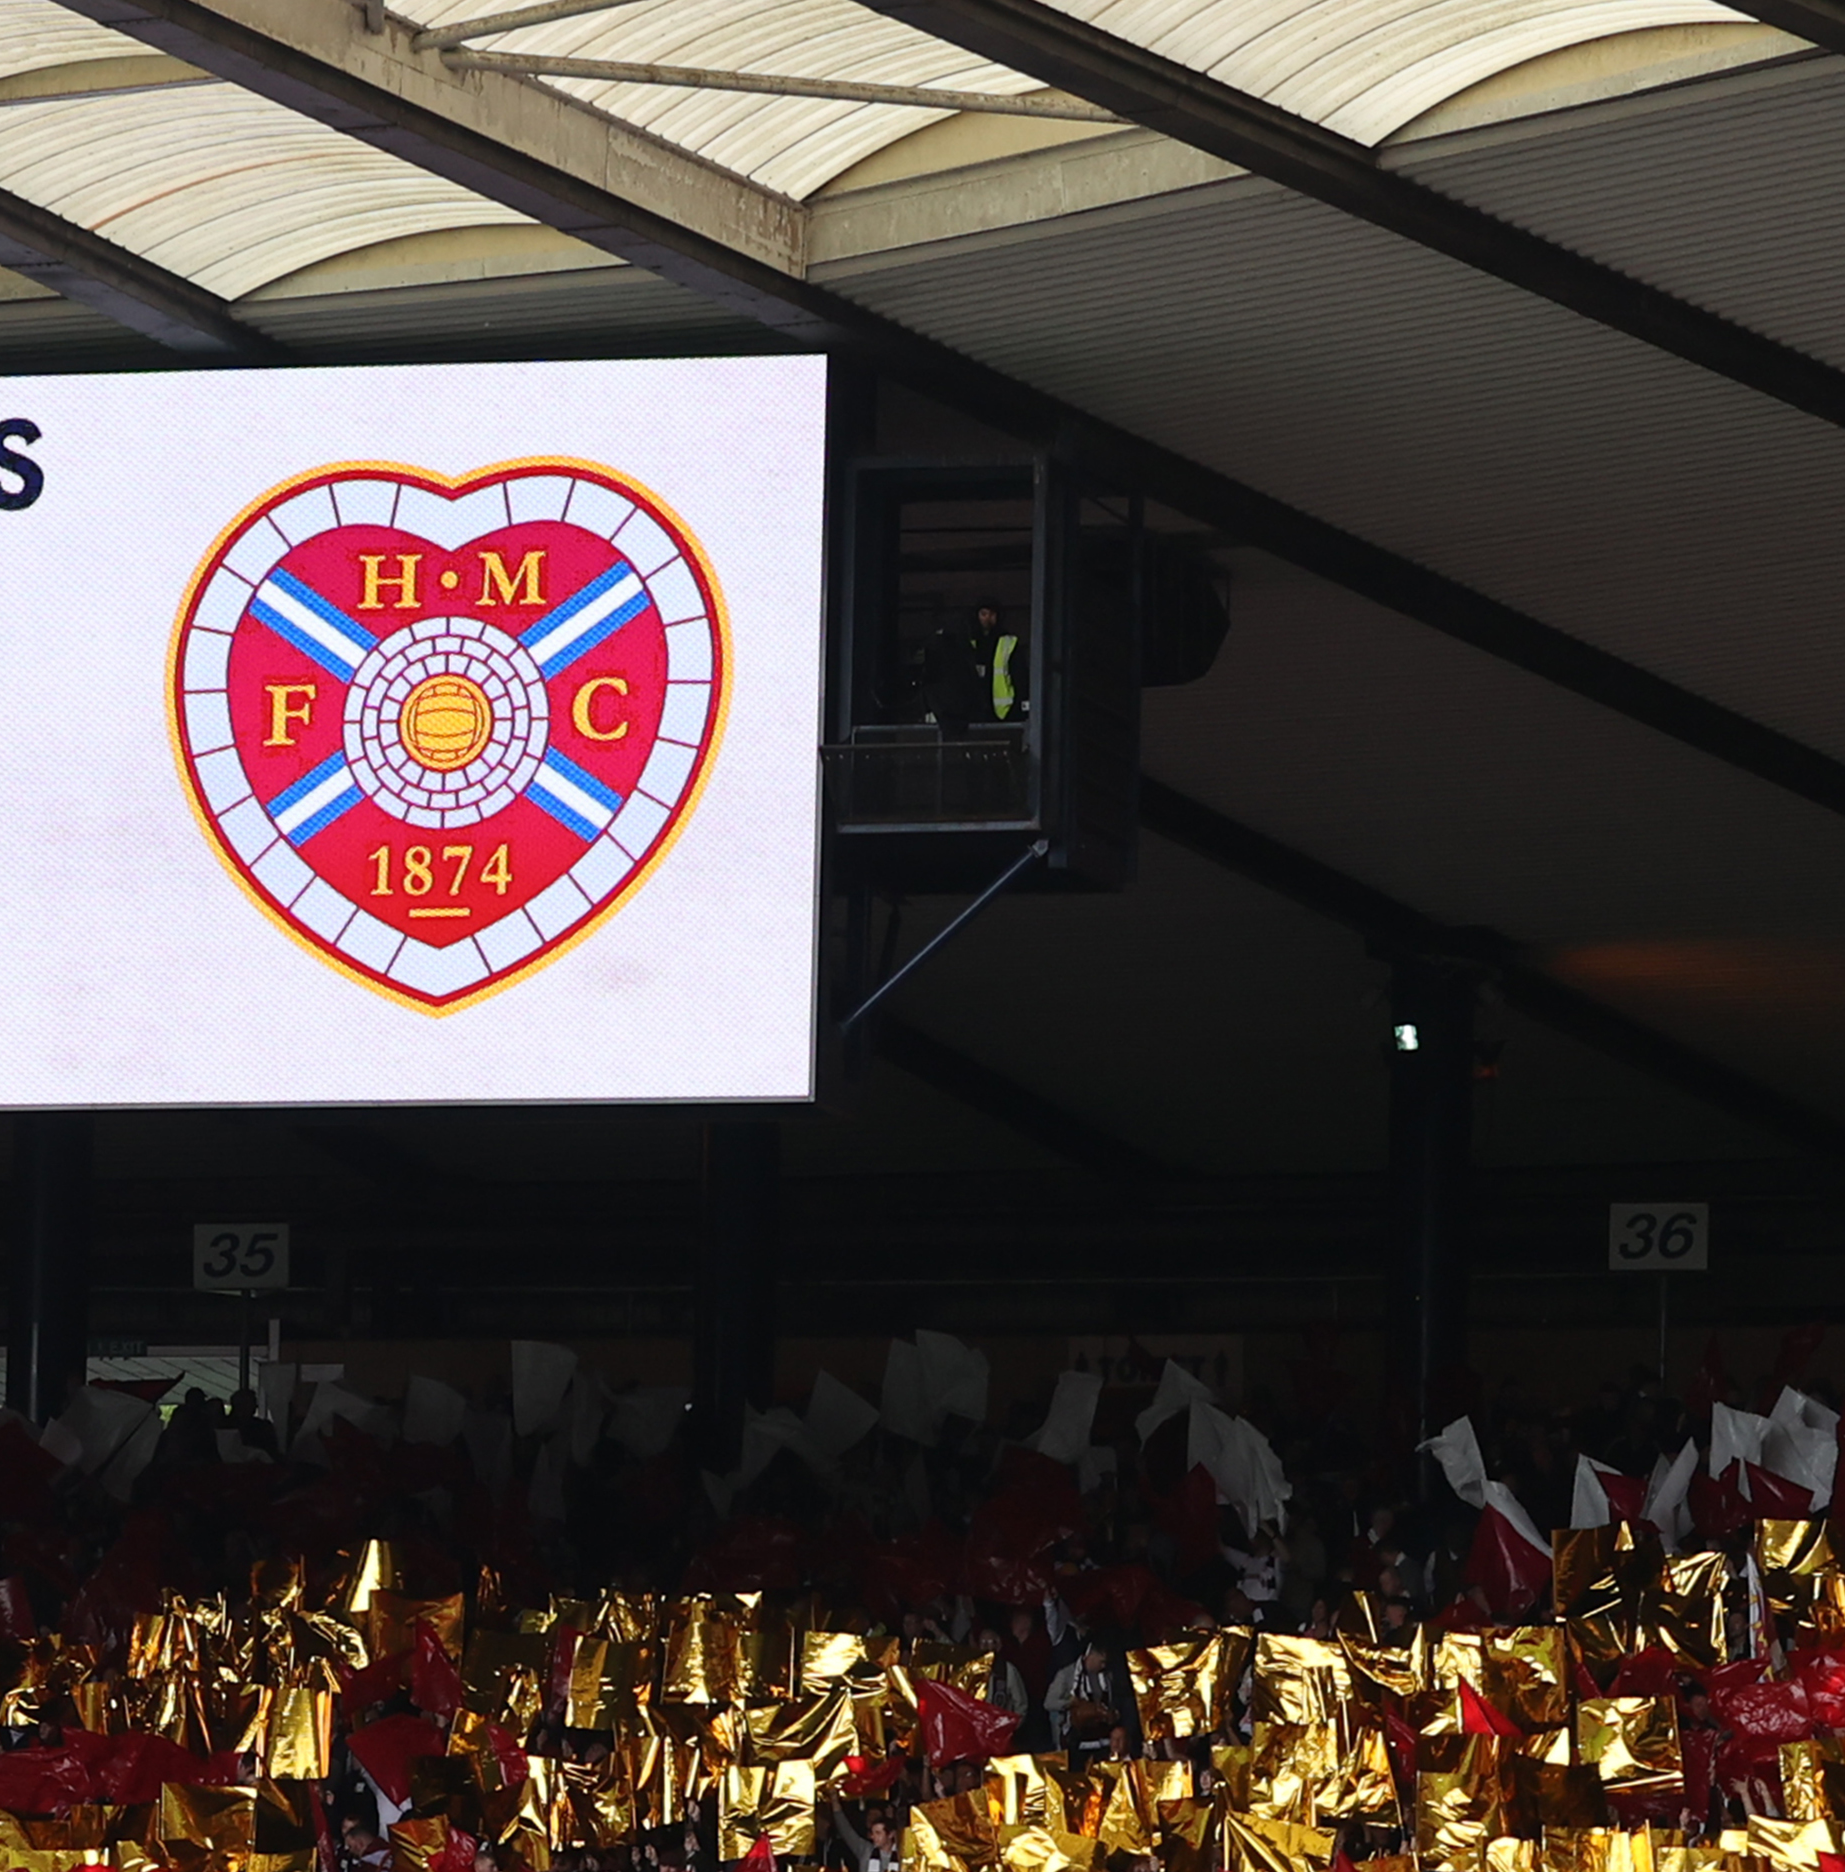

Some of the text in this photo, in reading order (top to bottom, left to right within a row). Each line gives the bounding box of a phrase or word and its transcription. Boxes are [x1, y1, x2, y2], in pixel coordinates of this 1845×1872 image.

[263, 684, 317, 746] F
[571, 677, 630, 741] C
[367, 844, 513, 896] 1874
[203, 1232, 279, 1278] 35
[1618, 1212, 1698, 1259] 36
